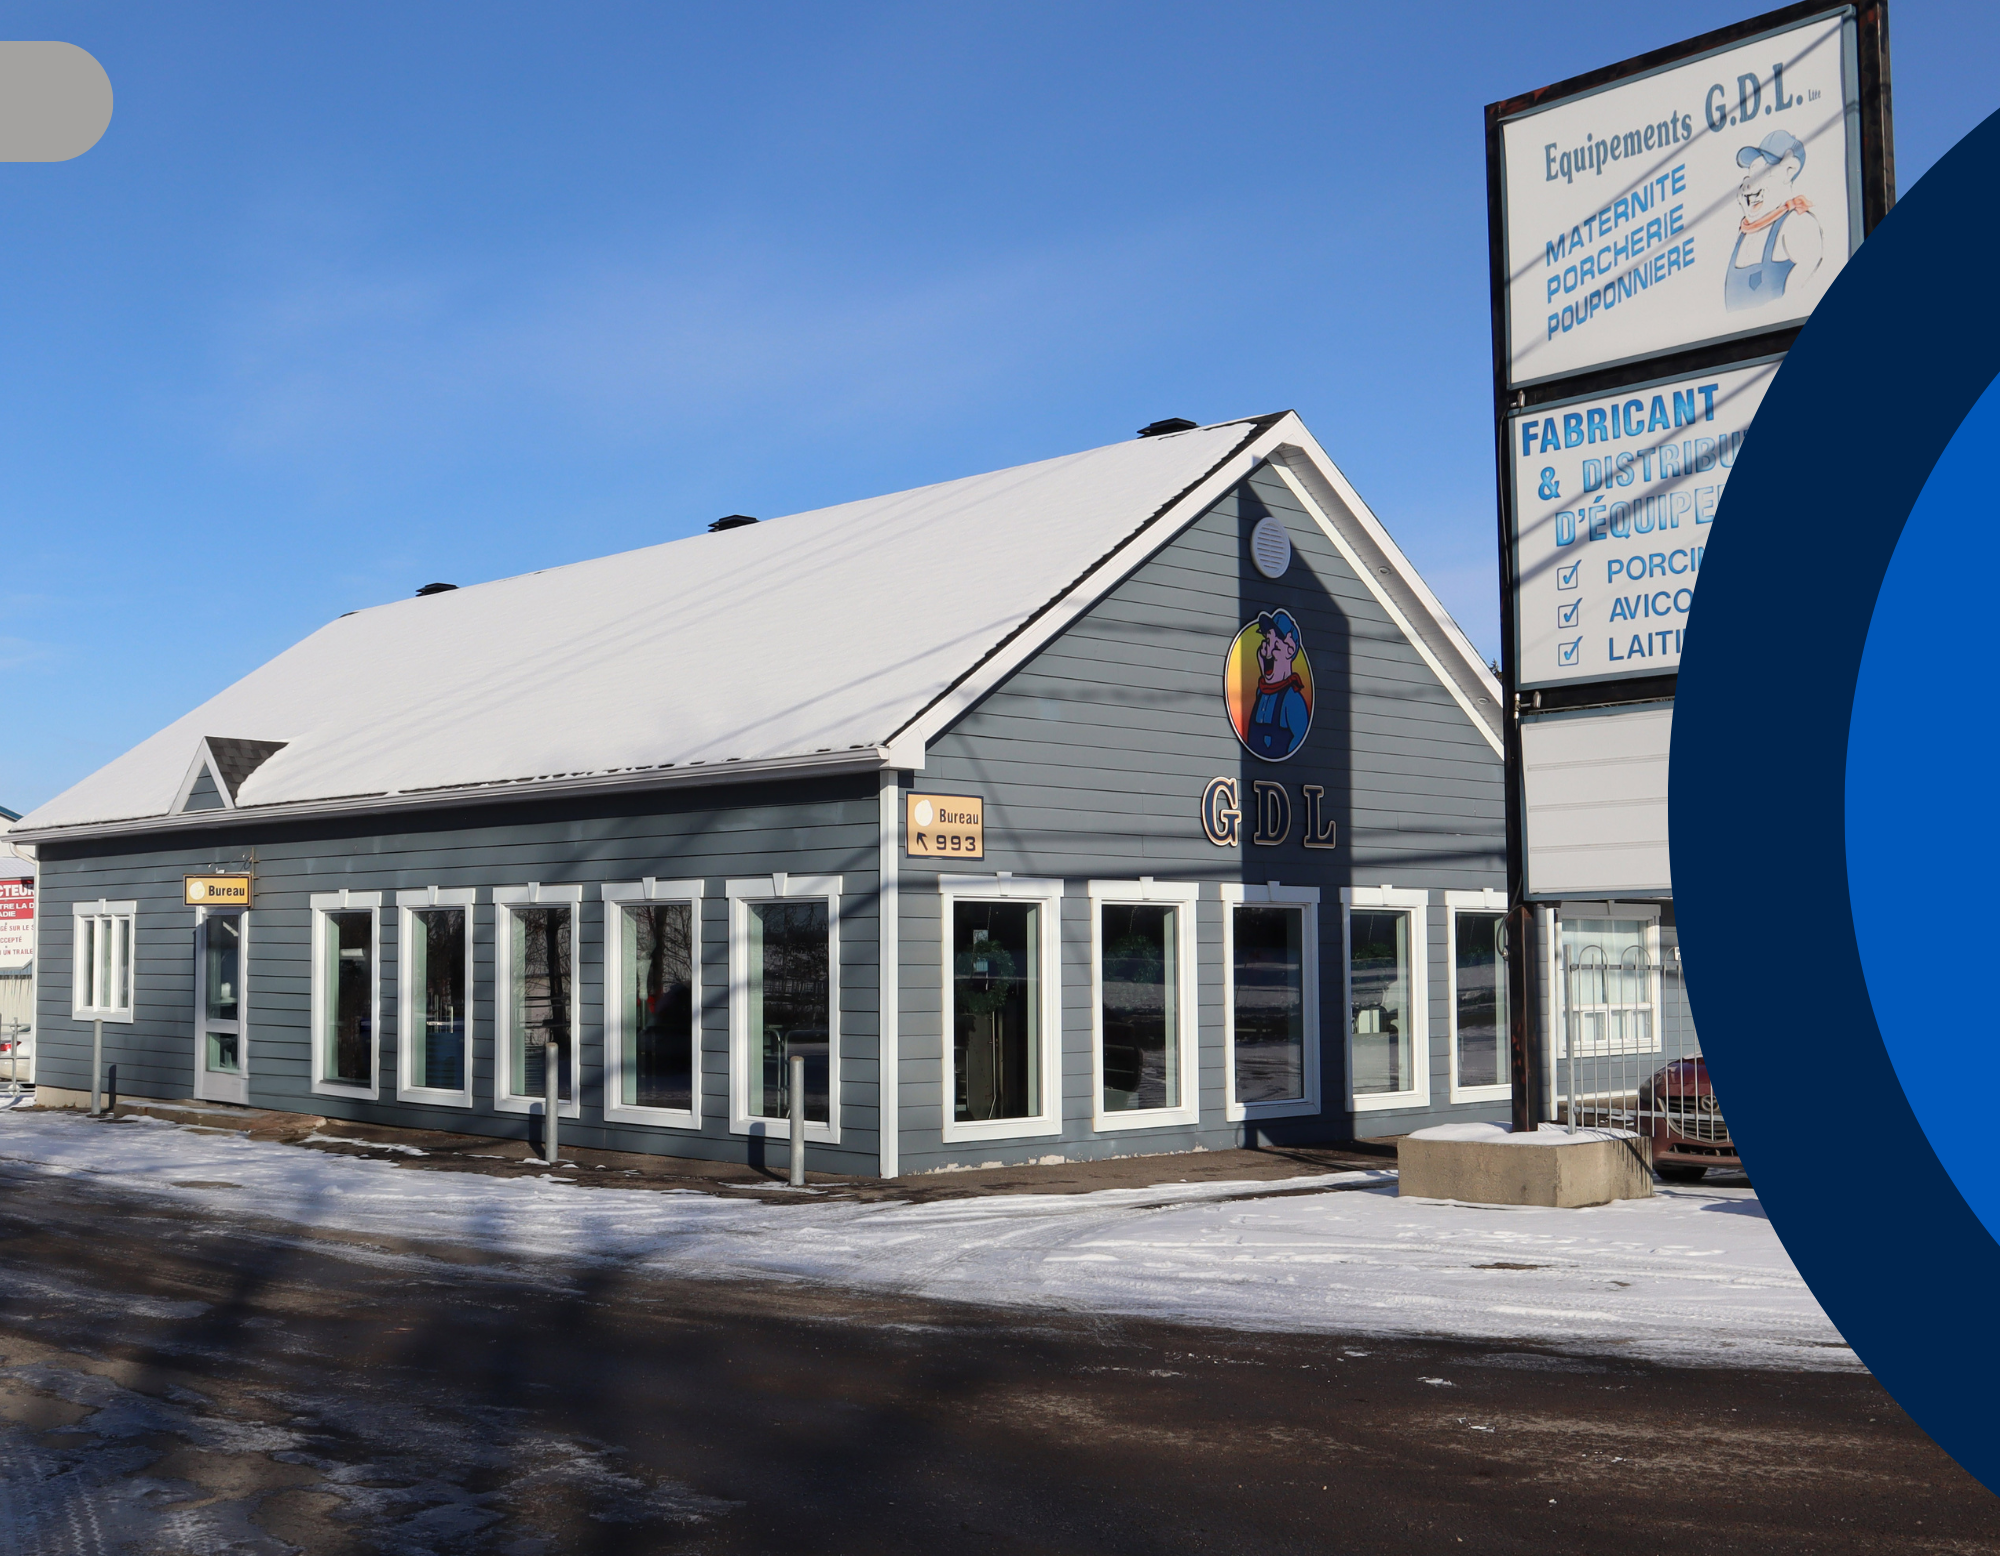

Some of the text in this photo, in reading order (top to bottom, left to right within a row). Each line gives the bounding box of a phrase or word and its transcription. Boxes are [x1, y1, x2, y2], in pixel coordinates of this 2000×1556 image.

[1545, 110, 1693, 184] Equipements
[1705, 62, 1804, 133] G.D.L.
[1546, 163, 1687, 266] MATERNITE
[1547, 203, 1685, 304] PORCHERIE
[1547, 237, 1696, 341] POUPONNIERE
[1521, 383, 1719, 457] FABRICANT
[1538, 429, 1748, 501] & DISTRIBU
[1555, 484, 1726, 547] D'ÉQUIPE
[1608, 628, 1686, 661] LAITI
[935, 835, 977, 853] 993
[939, 807, 979, 827] Bureau
[208, 885, 245, 897] Bureau
